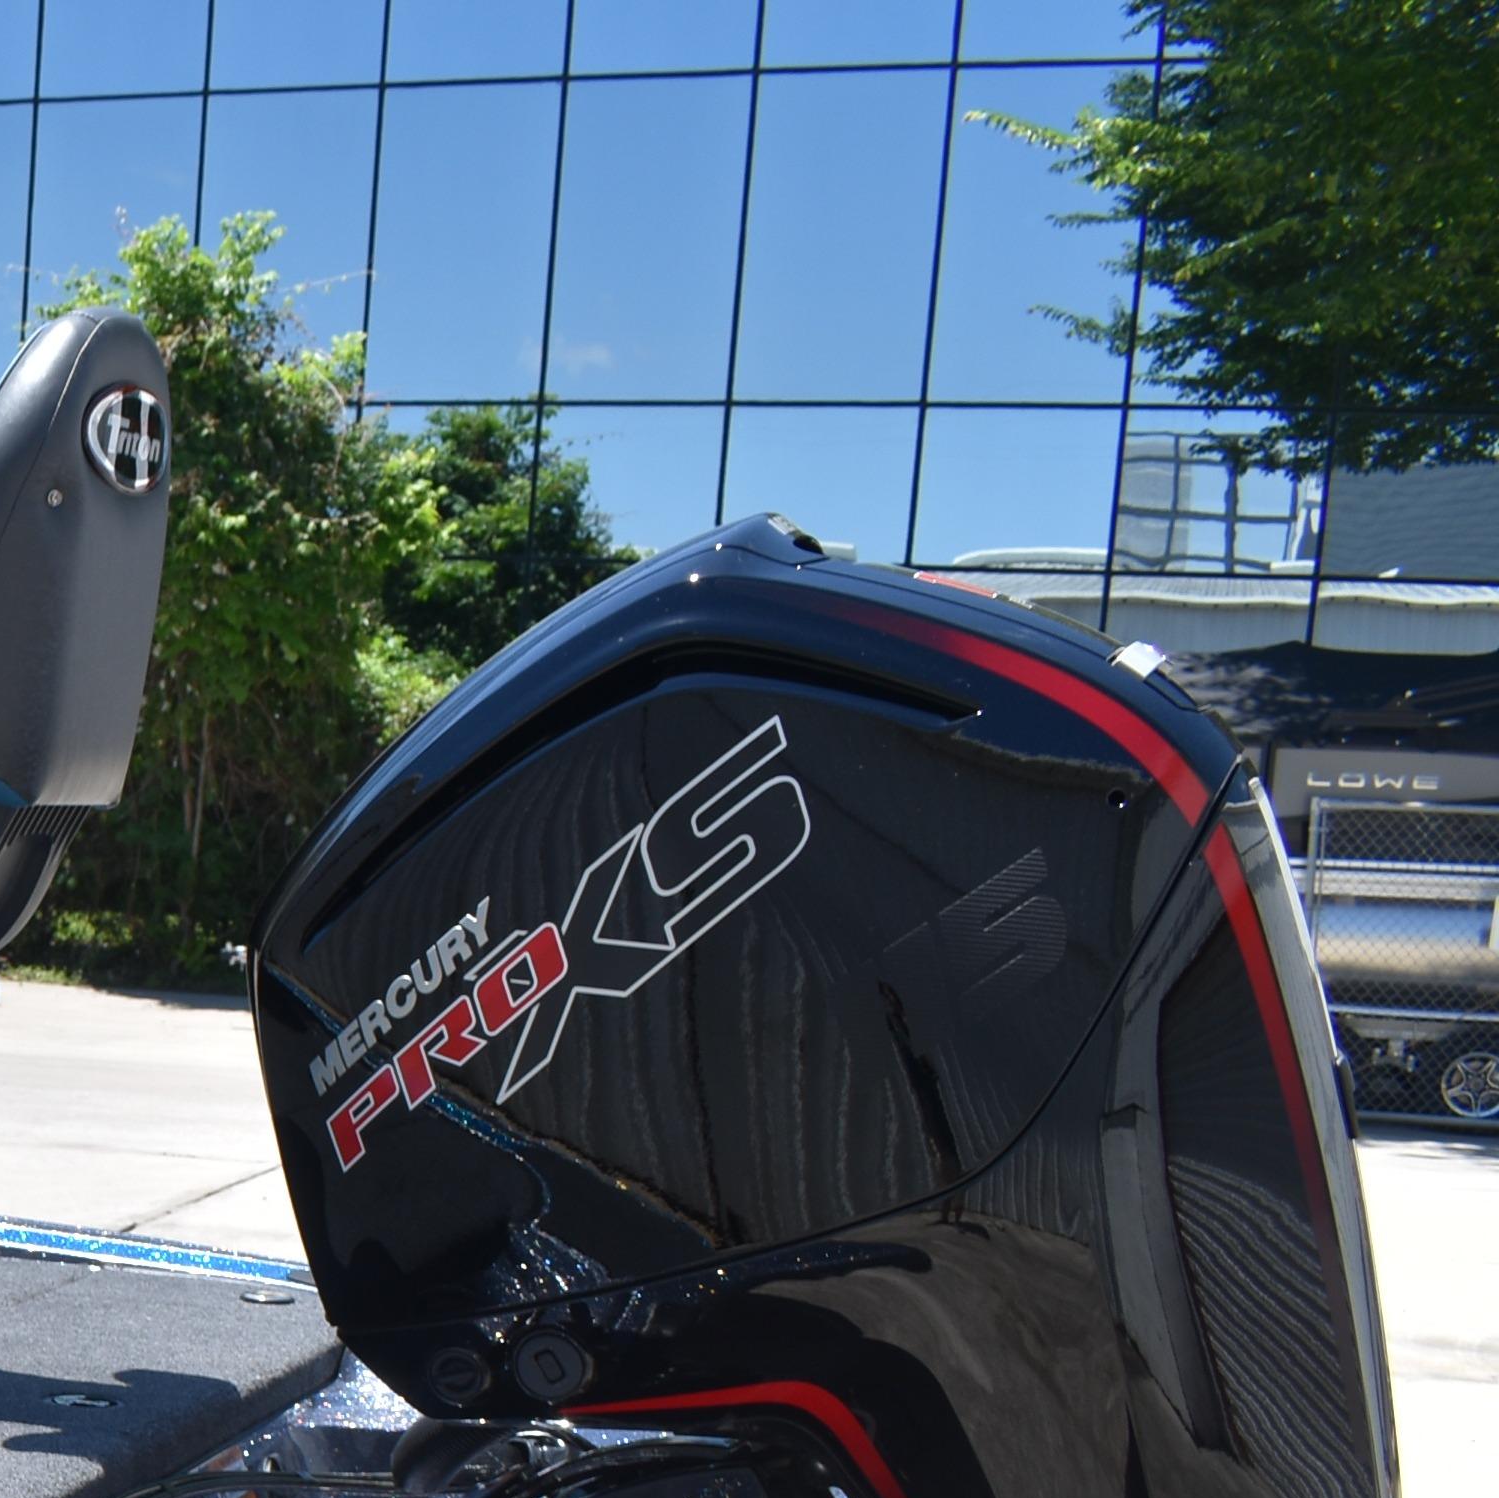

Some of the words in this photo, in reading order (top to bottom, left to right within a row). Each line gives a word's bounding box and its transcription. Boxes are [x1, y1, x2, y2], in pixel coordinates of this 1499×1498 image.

[106, 412, 162, 464] Triton
[1306, 771, 1440, 791] LOWE
[308, 895, 491, 1097] MERCURY
[325, 921, 569, 1173] PRO
[496, 713, 811, 1106] XS
